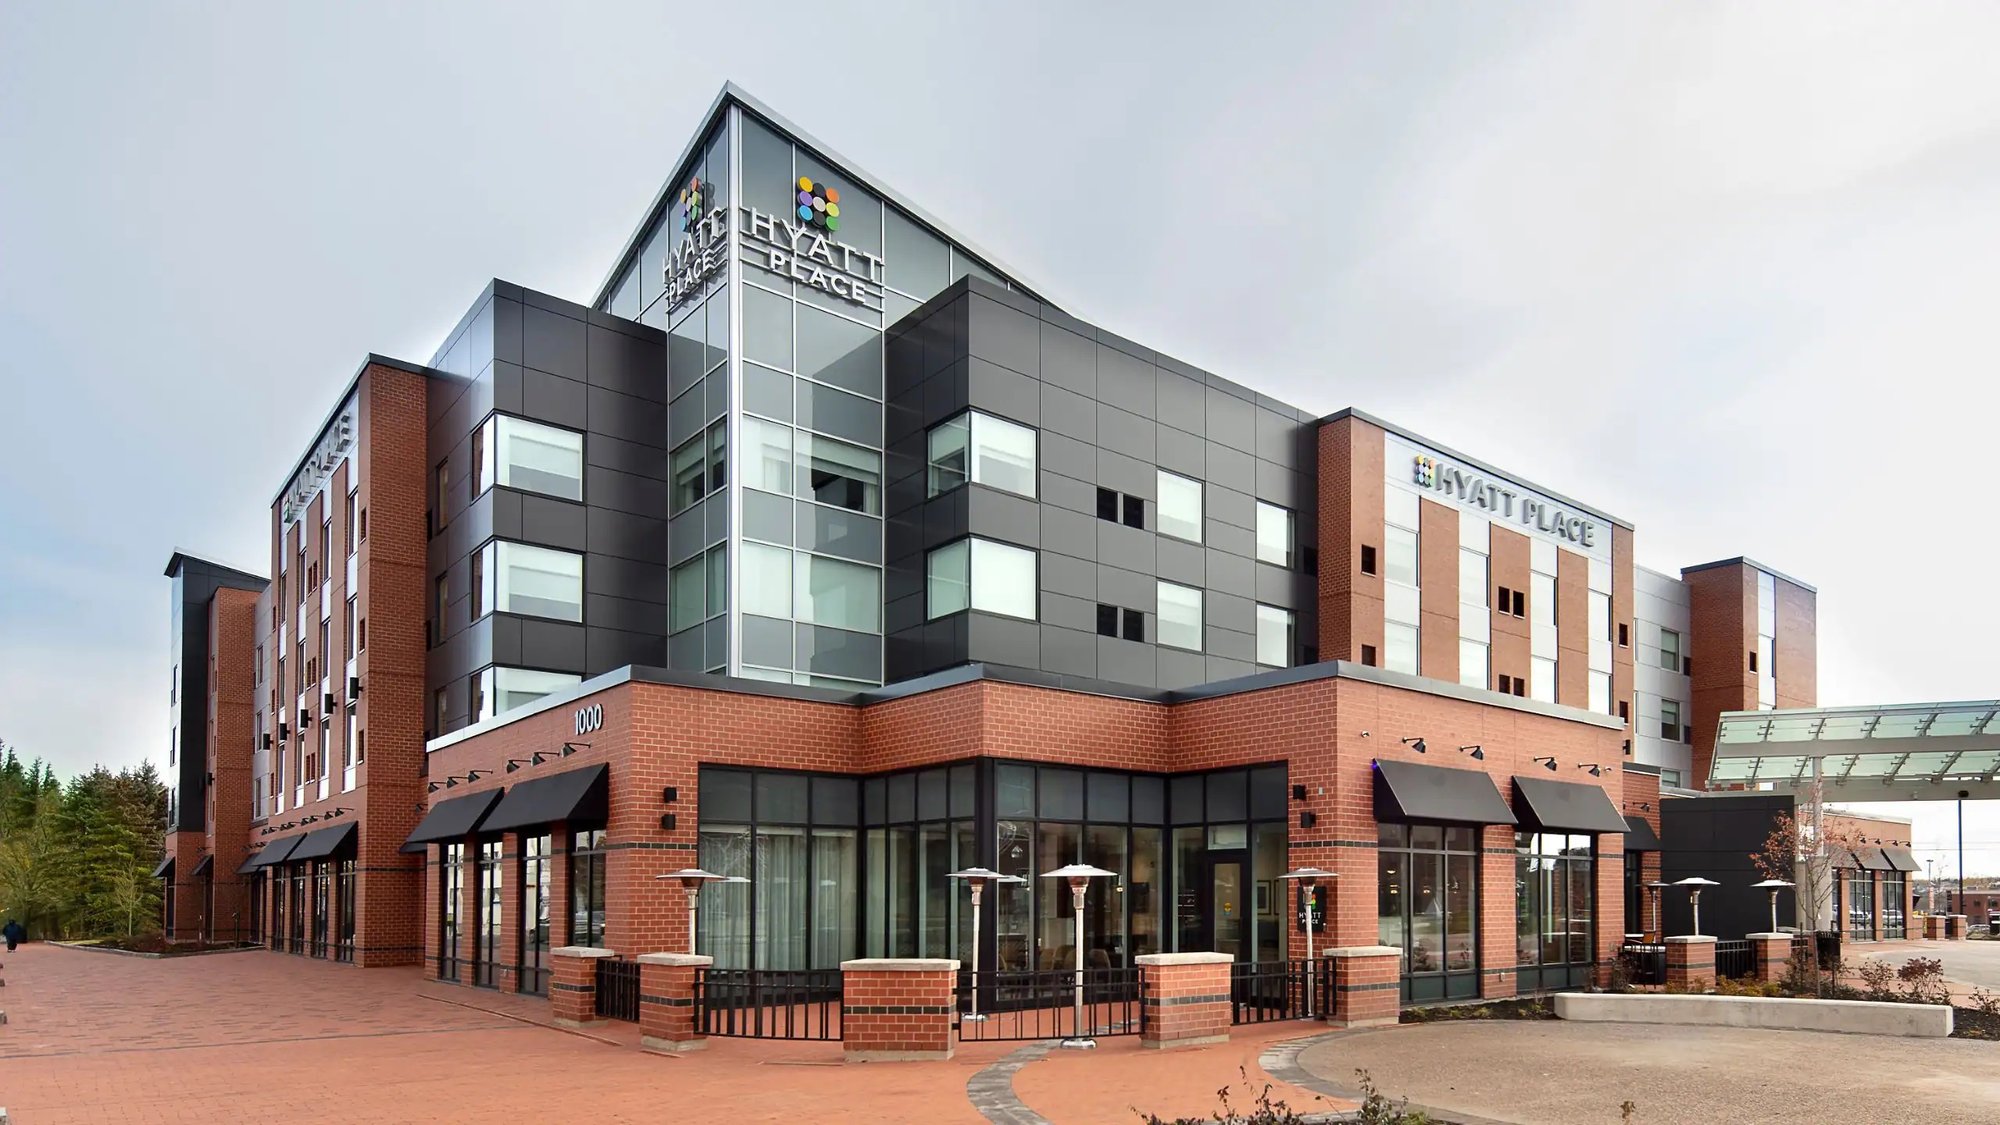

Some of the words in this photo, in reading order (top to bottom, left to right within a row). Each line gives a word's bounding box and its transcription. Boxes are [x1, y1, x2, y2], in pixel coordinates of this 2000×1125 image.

[662, 206, 723, 285] HYATT
[751, 207, 882, 282] HYATT
[669, 249, 718, 304] PLACE
[770, 249, 866, 303] PLACE
[1435, 463, 1517, 518] HYATT
[1522, 498, 1595, 548] PLACE
[575, 703, 603, 736] 1000
[1298, 911, 1321, 919] HTT
